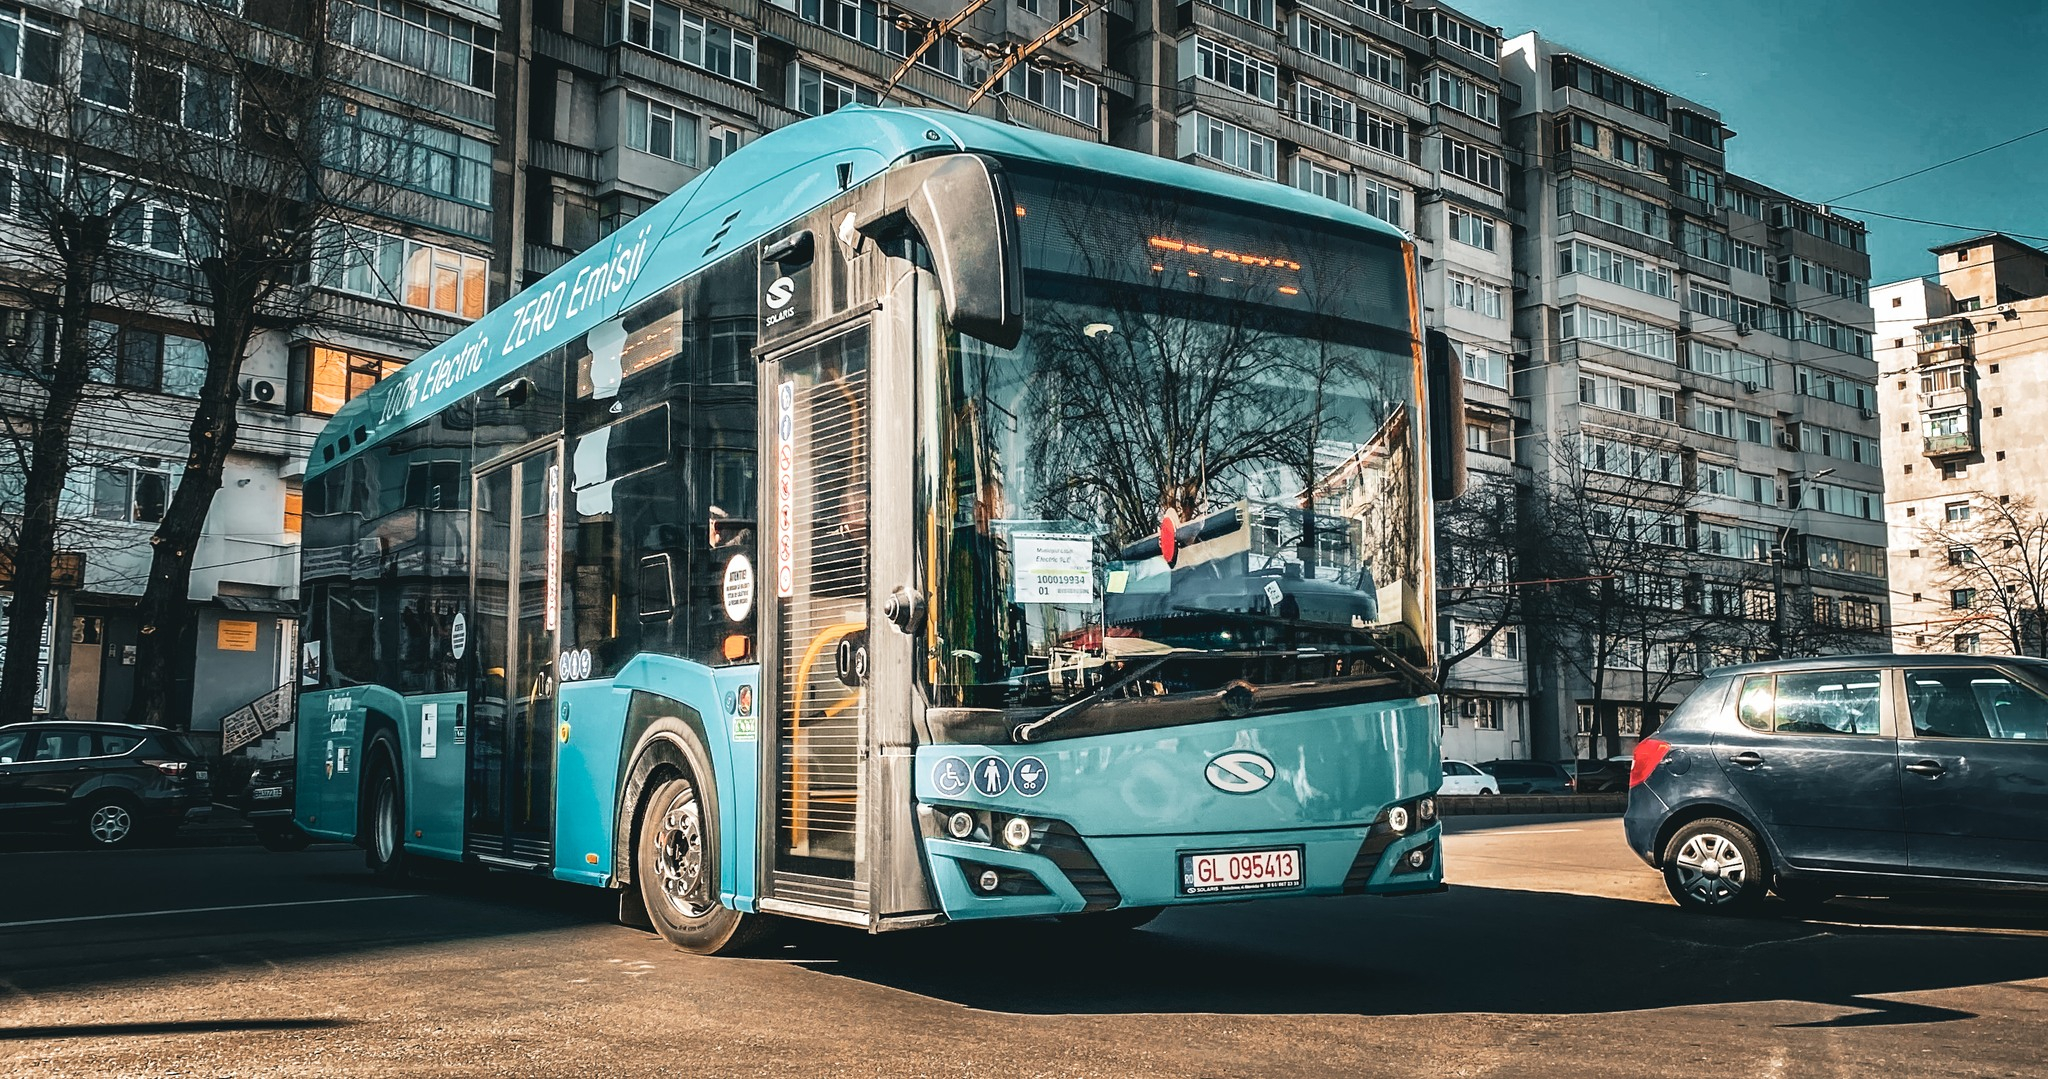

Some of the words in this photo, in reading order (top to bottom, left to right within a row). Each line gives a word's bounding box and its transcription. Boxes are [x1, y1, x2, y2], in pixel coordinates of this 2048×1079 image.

[379, 370, 423, 425] 100%
[420, 331, 488, 402] Electric
[502, 281, 567, 356] ZERO
[566, 224, 652, 319] Emisii
[766, 307, 795, 327] SOLARIS
[1038, 586, 1049, 596] 01
[1198, 858, 1224, 882] GL
[1229, 853, 1293, 880] 095413
